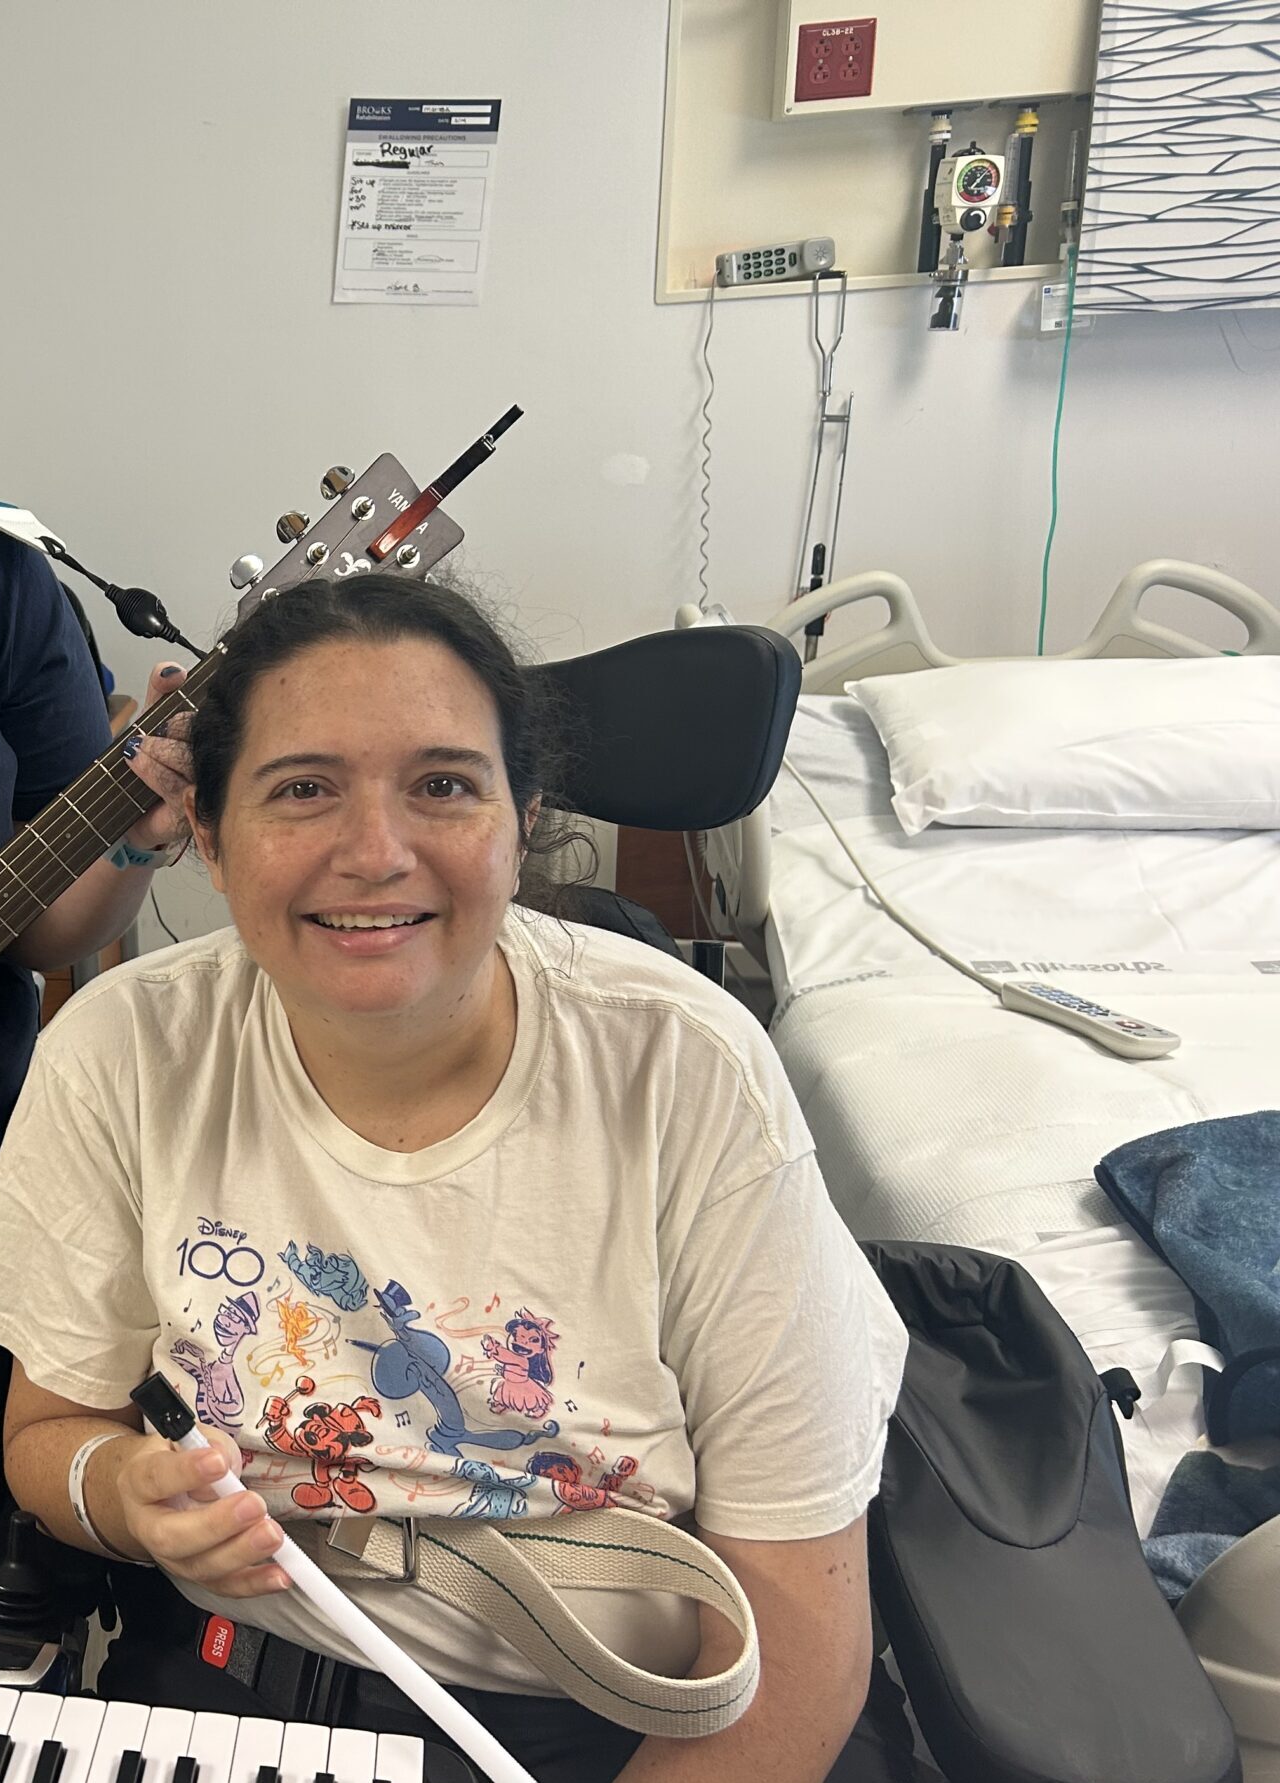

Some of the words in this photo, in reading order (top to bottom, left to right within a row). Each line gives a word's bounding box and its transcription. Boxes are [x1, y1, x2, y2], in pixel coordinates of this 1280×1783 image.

[380, 142, 434, 160] Regular
[196, 1216, 247, 1246] Disney
[176, 1237, 265, 1288] 100
[211, 1626, 228, 1658] PRESS
